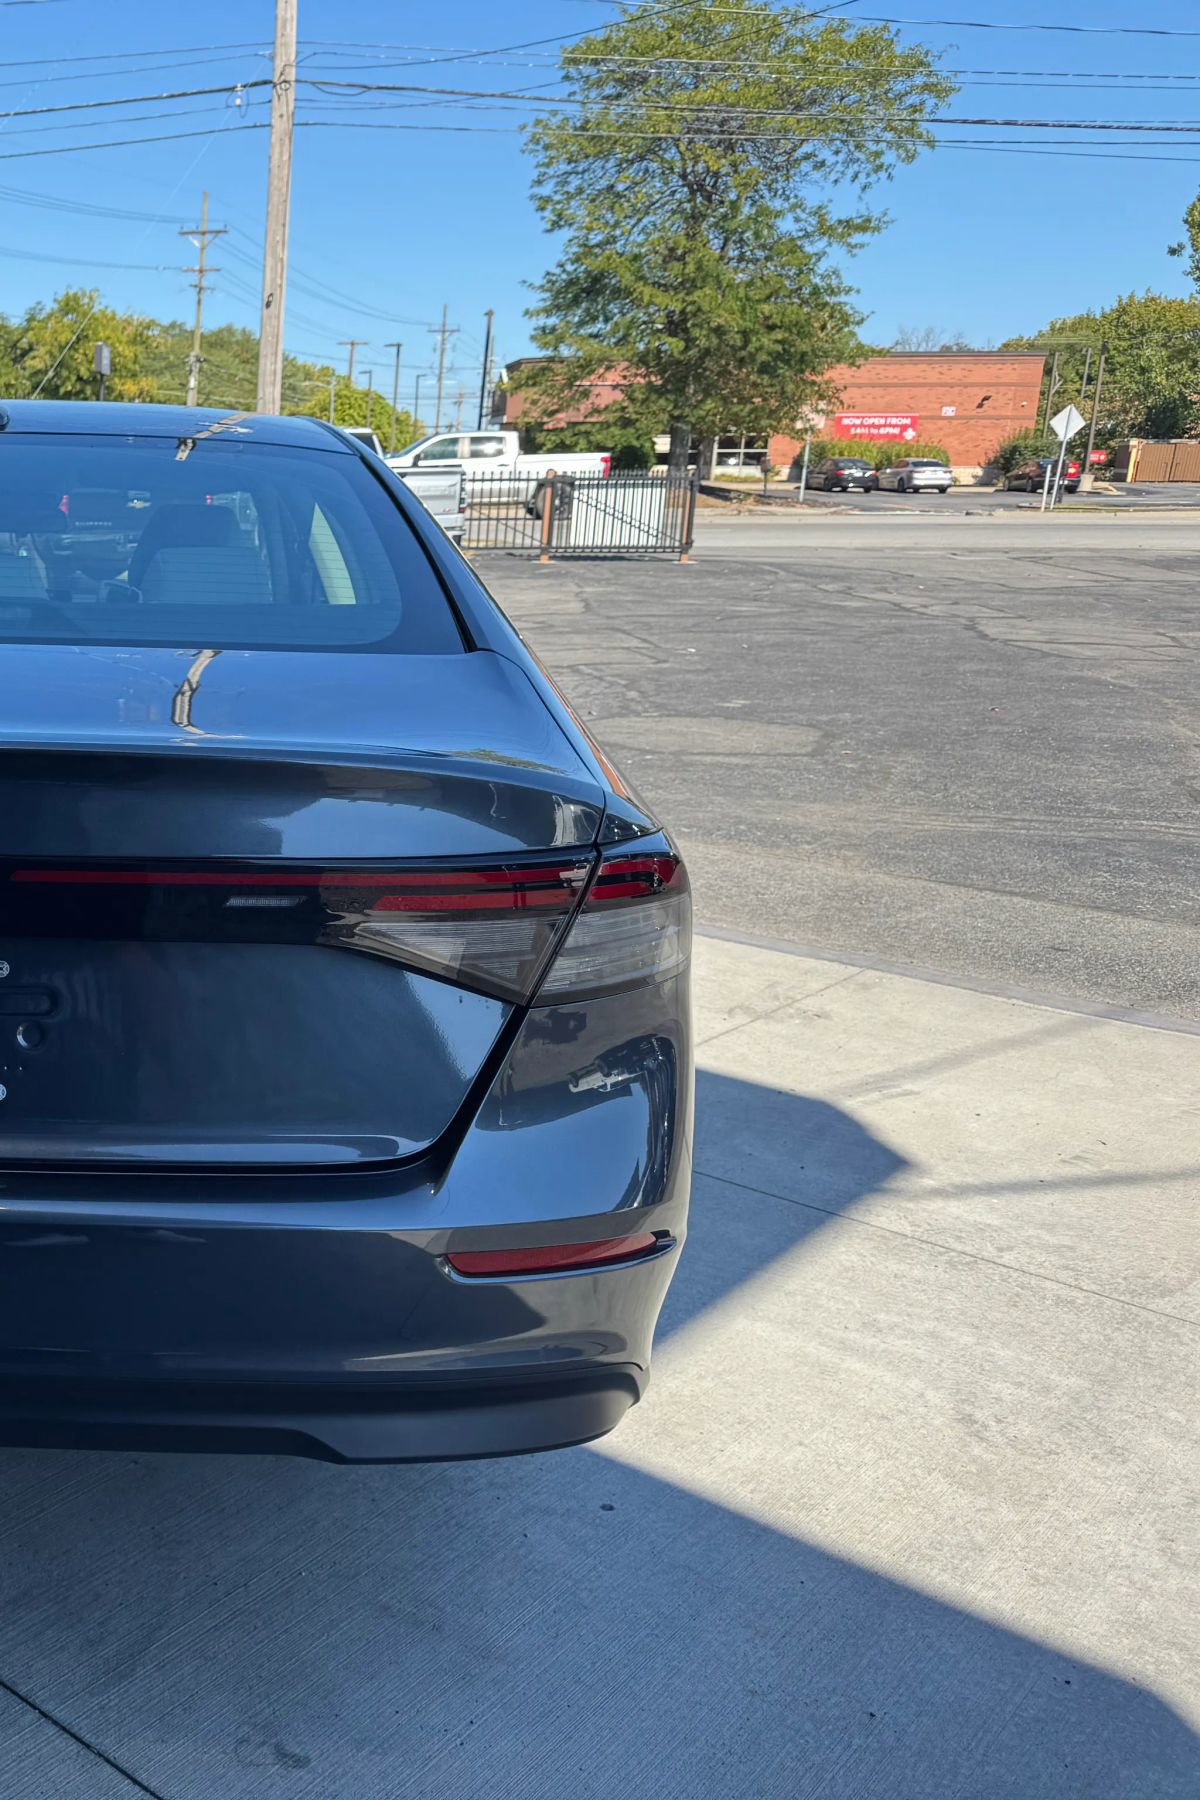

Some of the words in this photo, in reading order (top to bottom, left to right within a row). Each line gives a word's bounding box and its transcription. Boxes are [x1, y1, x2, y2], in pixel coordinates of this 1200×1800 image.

[841, 417, 863, 425] NOW
[863, 417, 886, 425] OPEN
[886, 417, 911, 425] FROM
